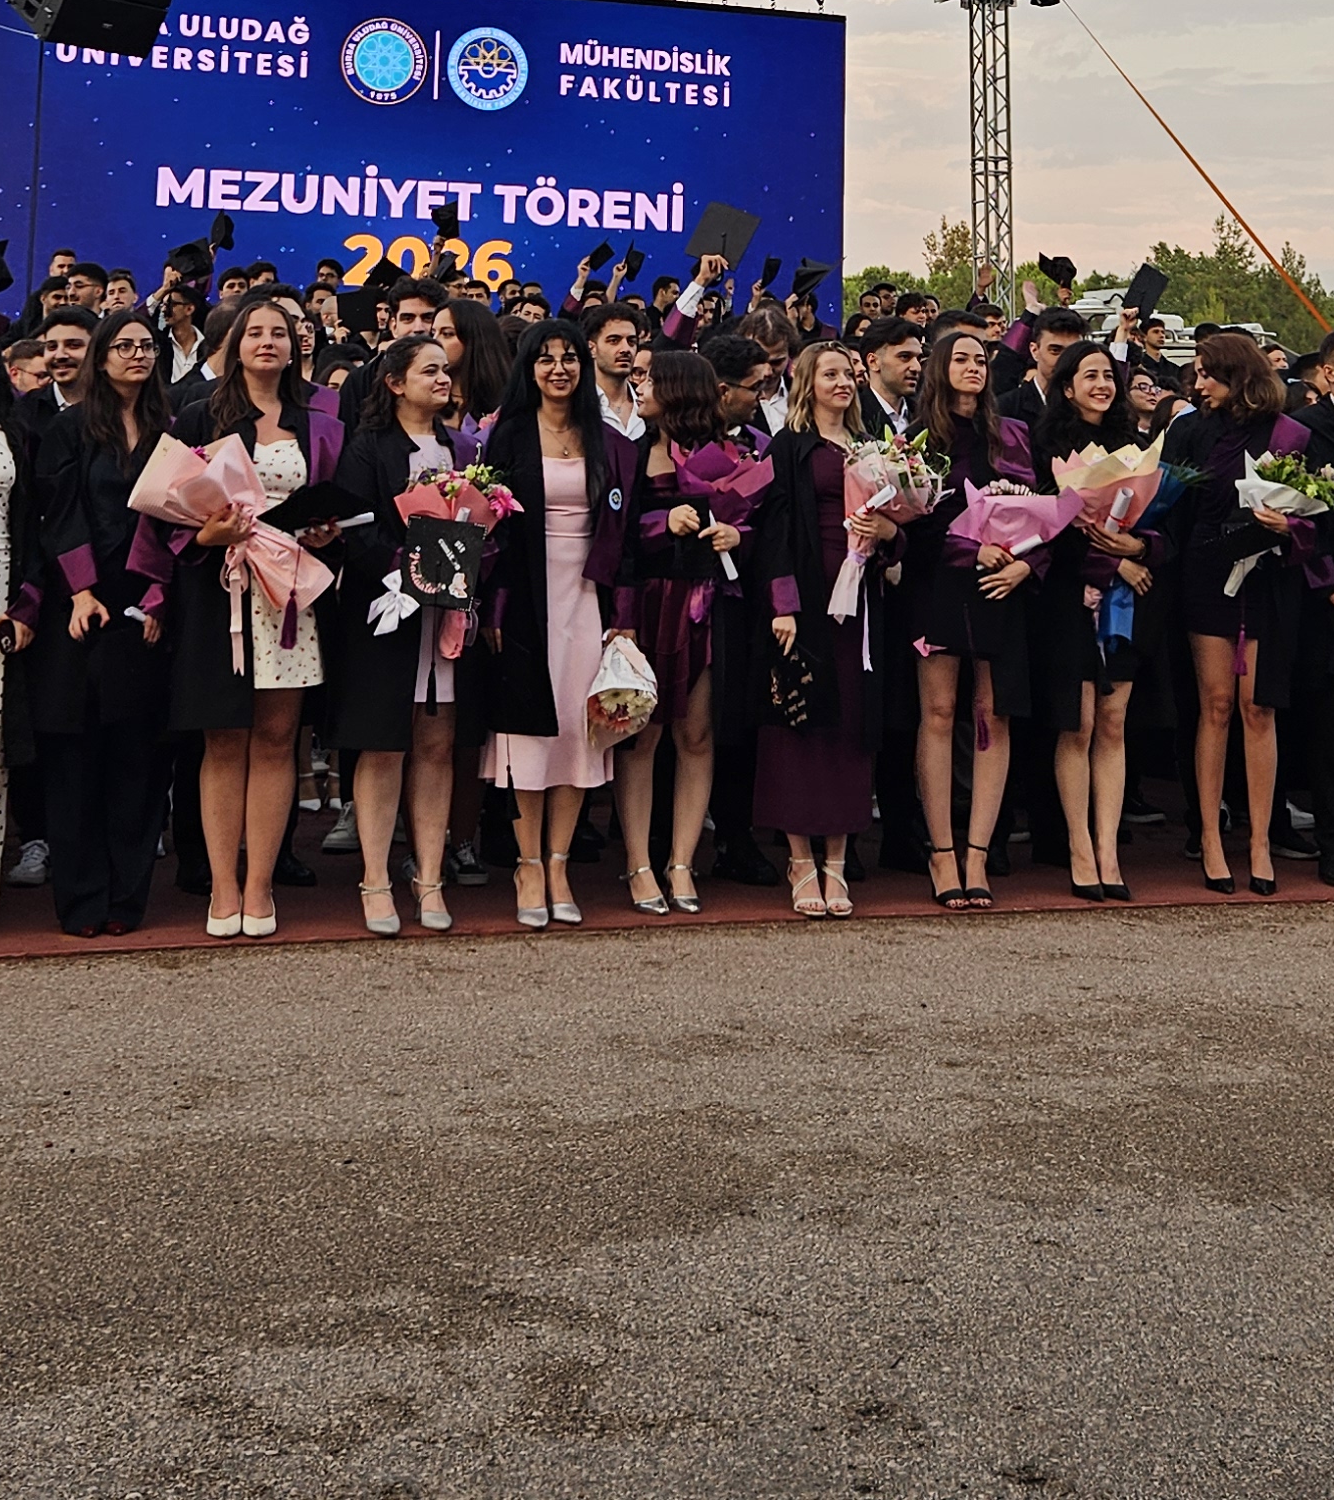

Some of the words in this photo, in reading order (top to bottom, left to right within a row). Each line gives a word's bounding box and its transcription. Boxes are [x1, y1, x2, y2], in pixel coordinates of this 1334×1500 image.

[179, 14, 310, 45] ULUDAĞ
[345, 43, 355, 76] BURSA
[560, 39, 732, 77] MÜHENDİSLİK
[560, 74, 731, 108] FAKÜLTESİ
[156, 164, 482, 222] MEZUNİYET
[495, 176, 684, 233] TÖRENİ
